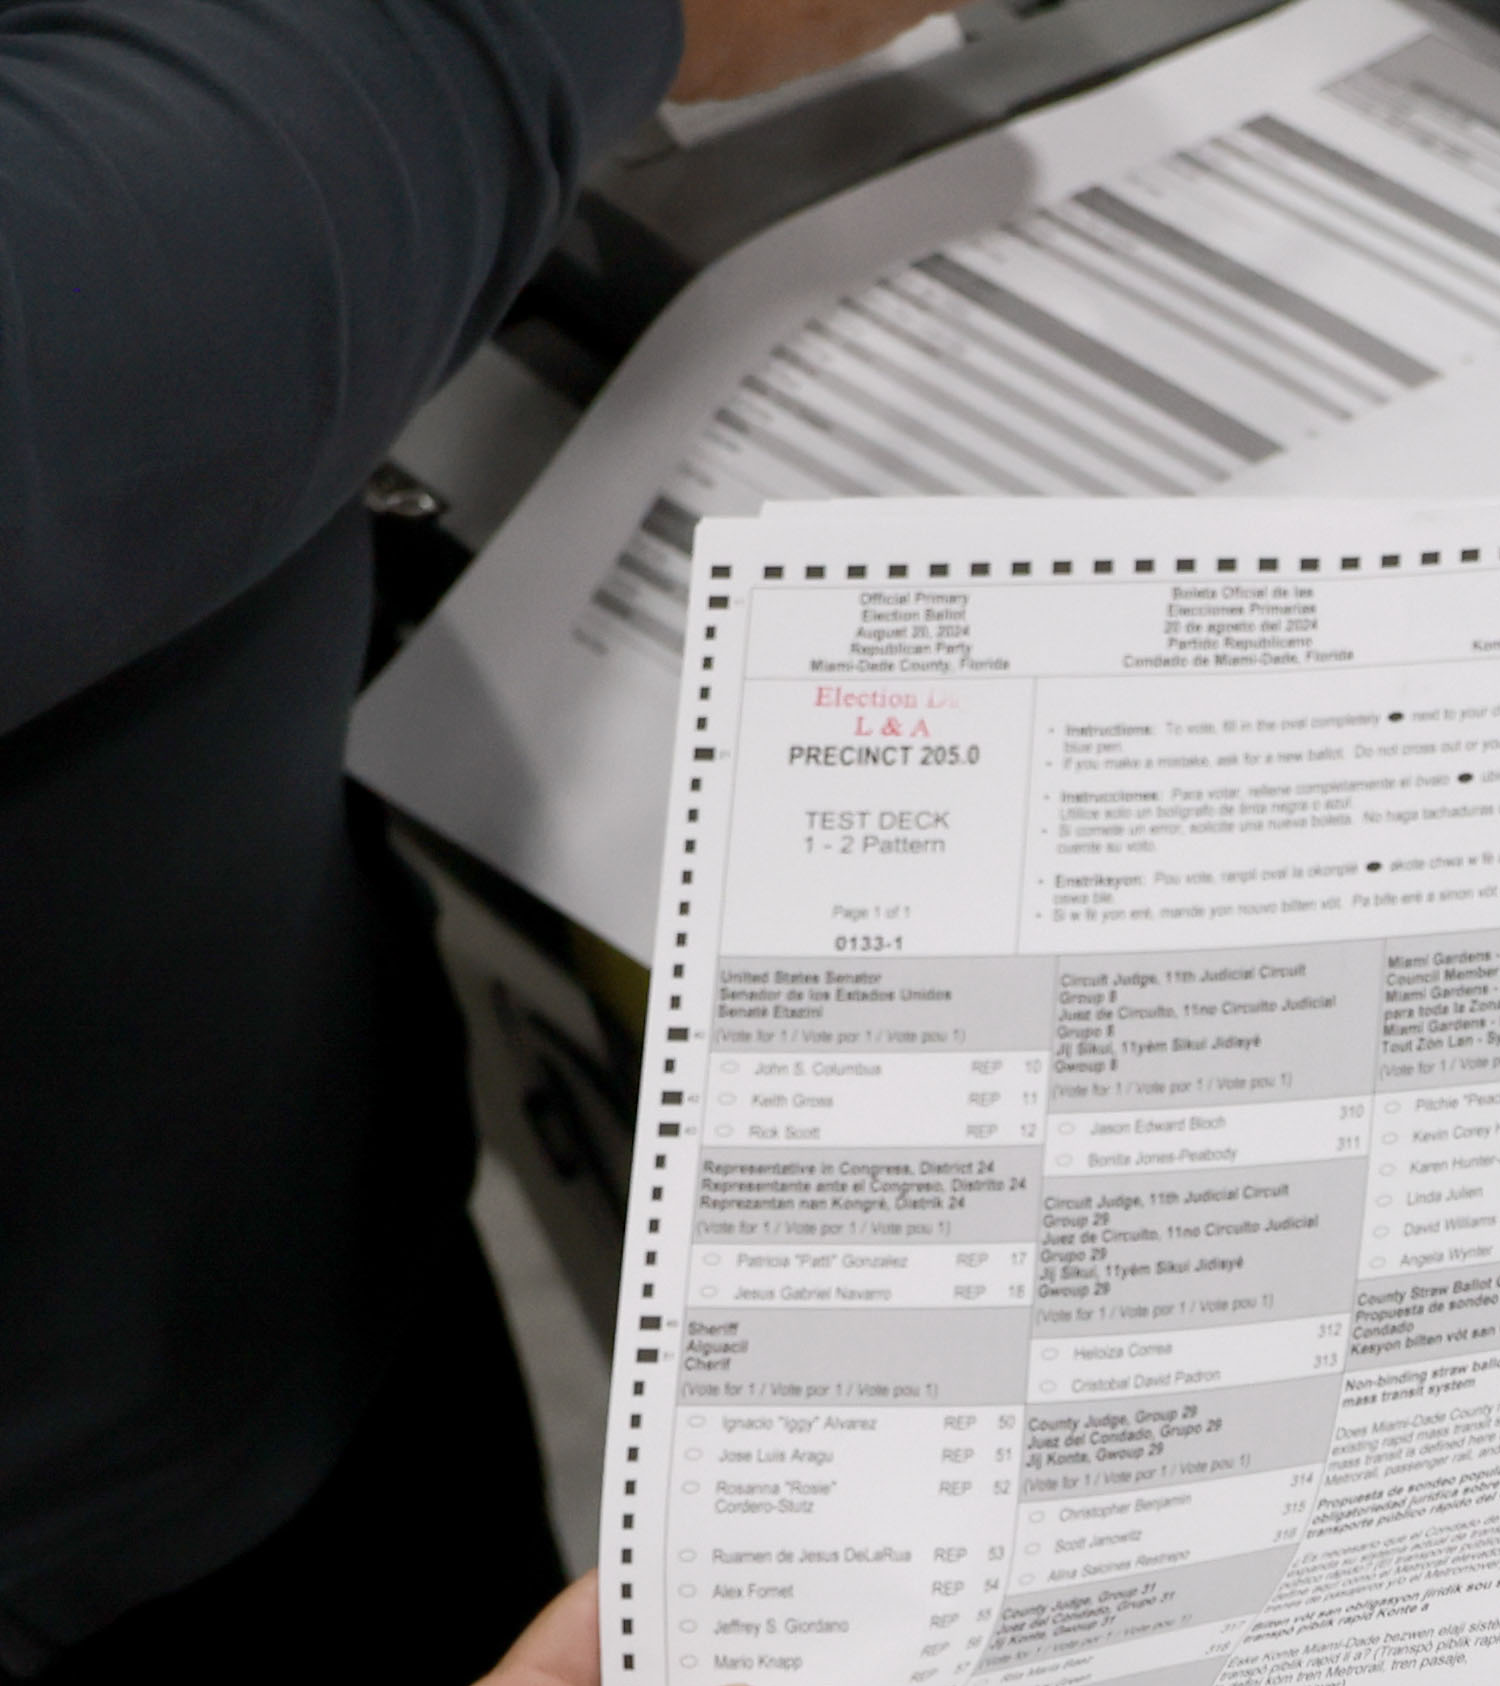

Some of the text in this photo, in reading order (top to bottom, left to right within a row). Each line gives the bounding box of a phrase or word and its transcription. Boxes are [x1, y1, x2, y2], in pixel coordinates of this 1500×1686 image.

[815, 686, 918, 709] Election
[854, 716, 930, 737] L & A
[789, 745, 980, 766] PRECINCT 205.0
[806, 811, 951, 829] TEST DECK
[840, 836, 854, 853] 2
[862, 836, 945, 854] Pattern
[832, 906, 867, 921] Page
[886, 905, 902, 919] of
[835, 936, 903, 951] 0133-1
